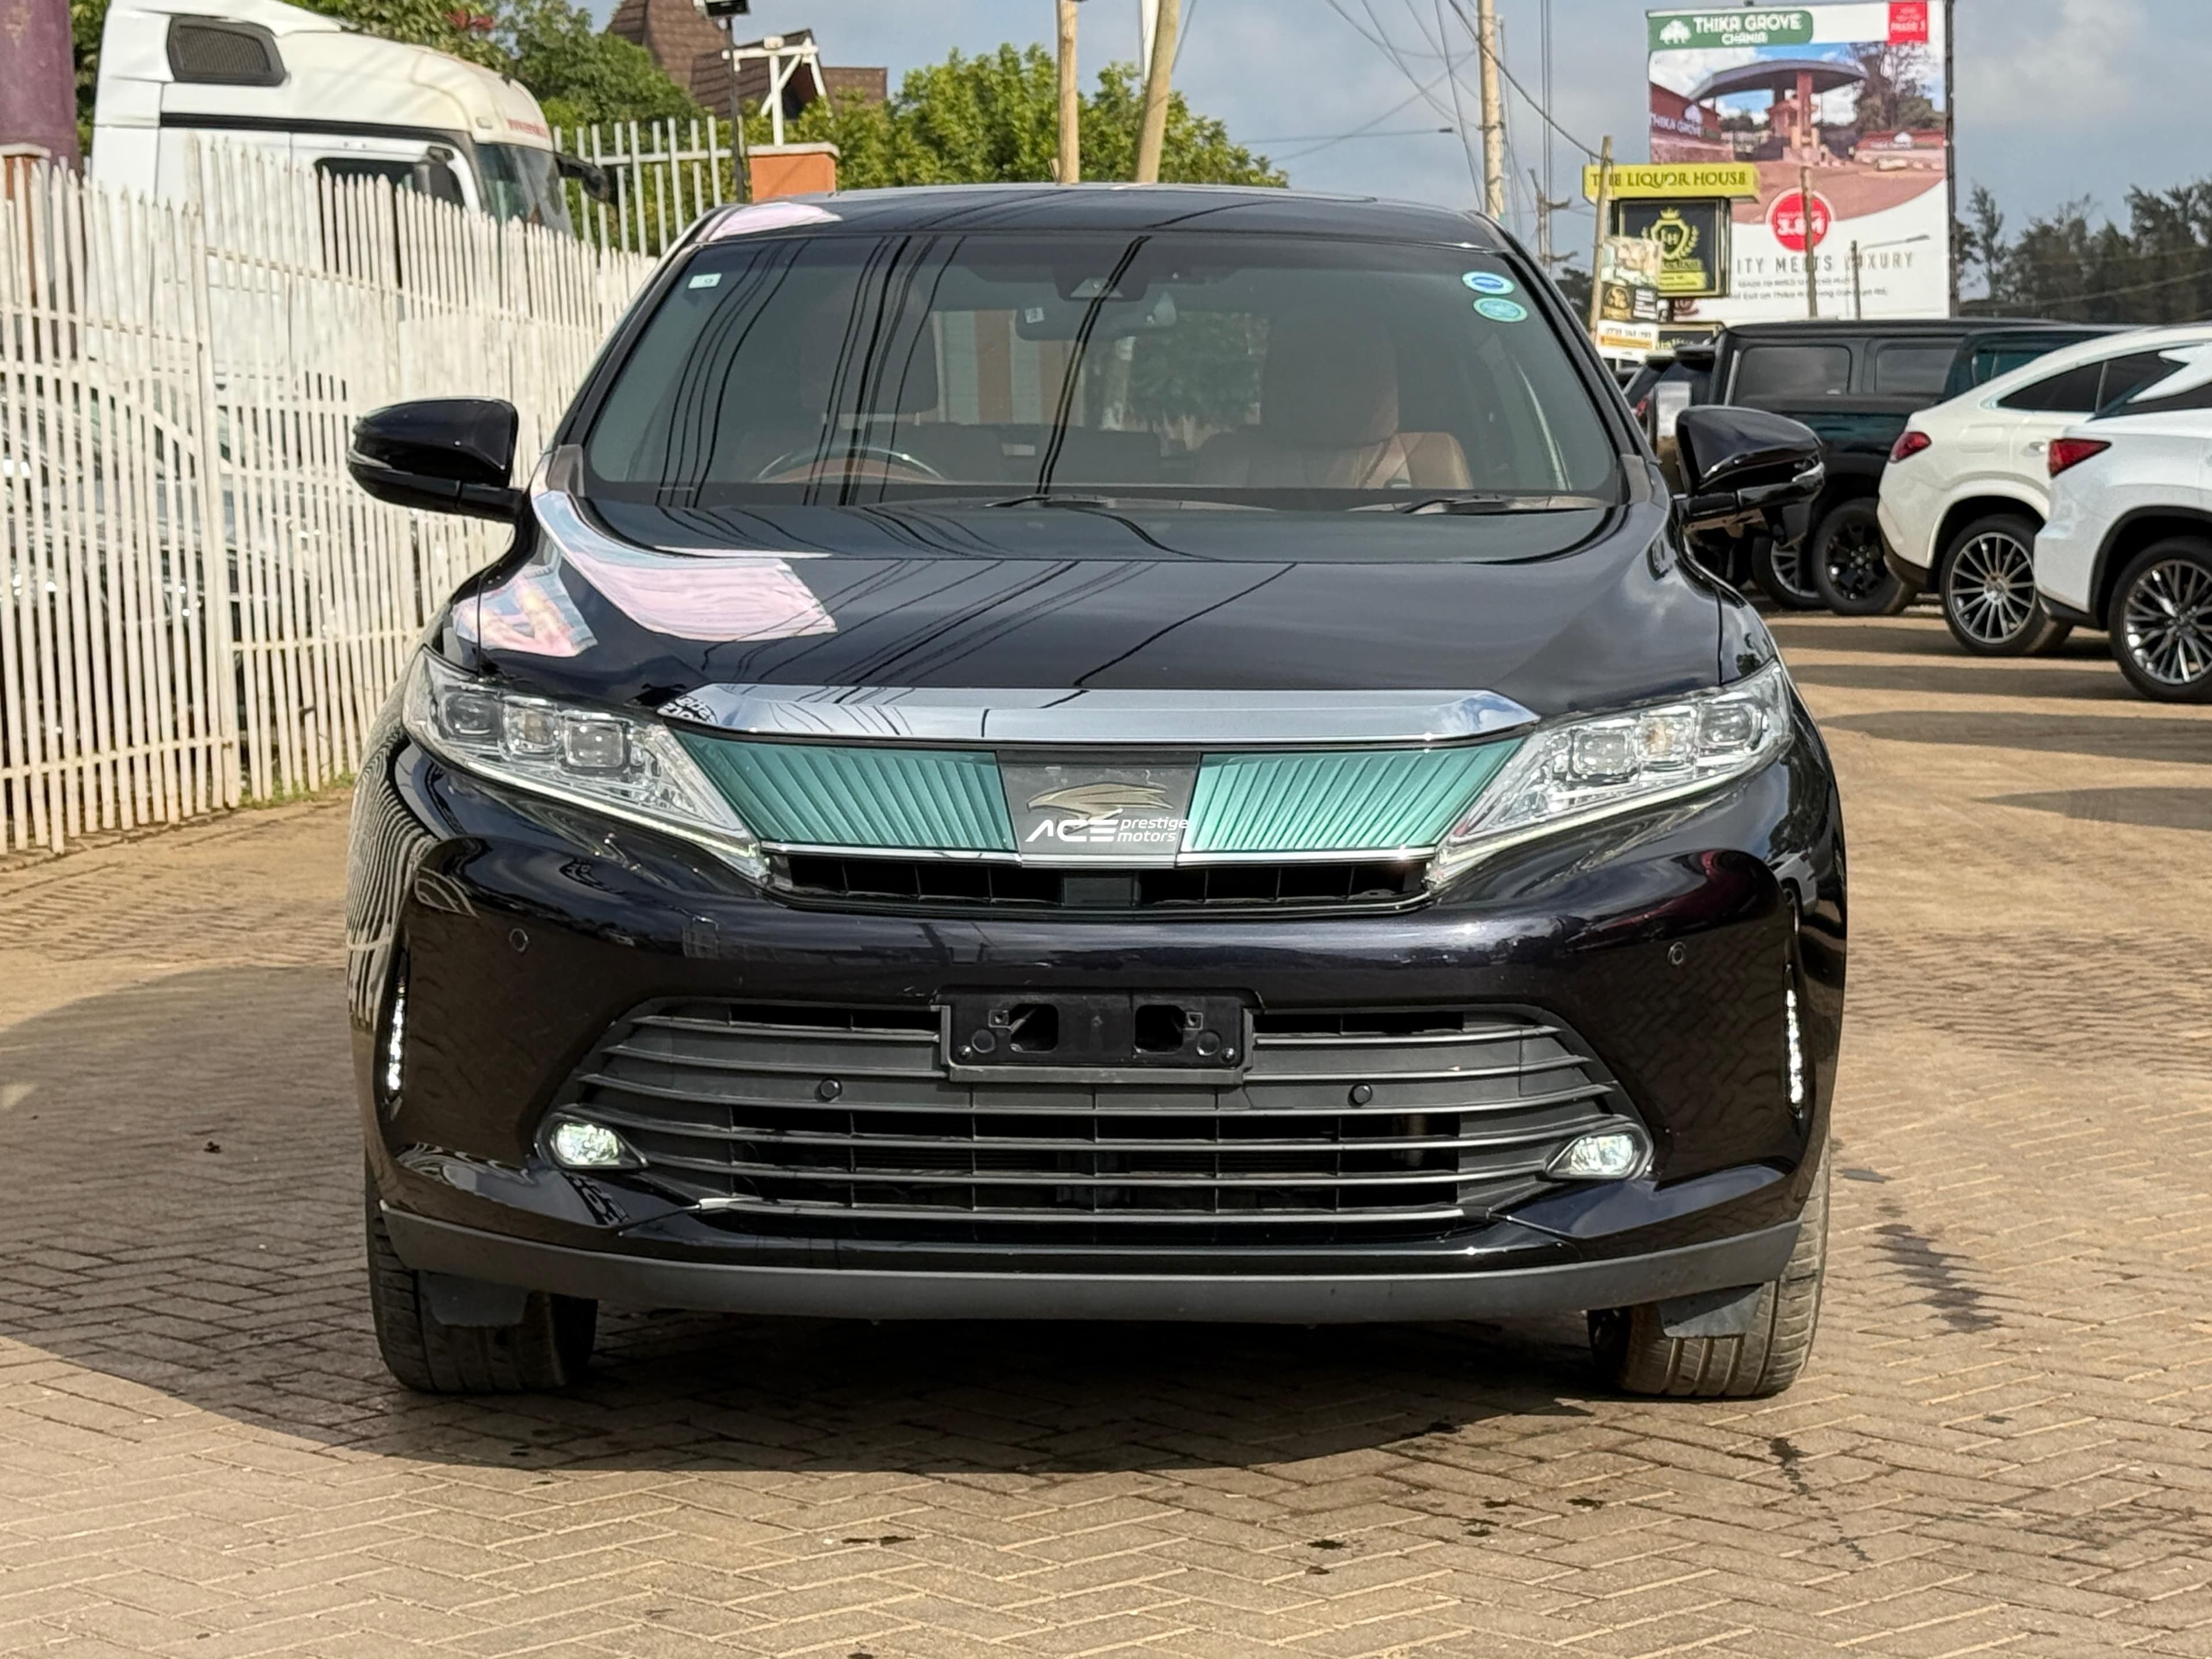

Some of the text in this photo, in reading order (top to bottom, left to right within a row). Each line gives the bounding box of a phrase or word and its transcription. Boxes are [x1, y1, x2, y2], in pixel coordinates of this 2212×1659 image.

[1693, 13, 1802, 34] THIKA GROVE
[1627, 172, 1690, 190] LIQUOR
[1694, 171, 1746, 186] HOUSE
